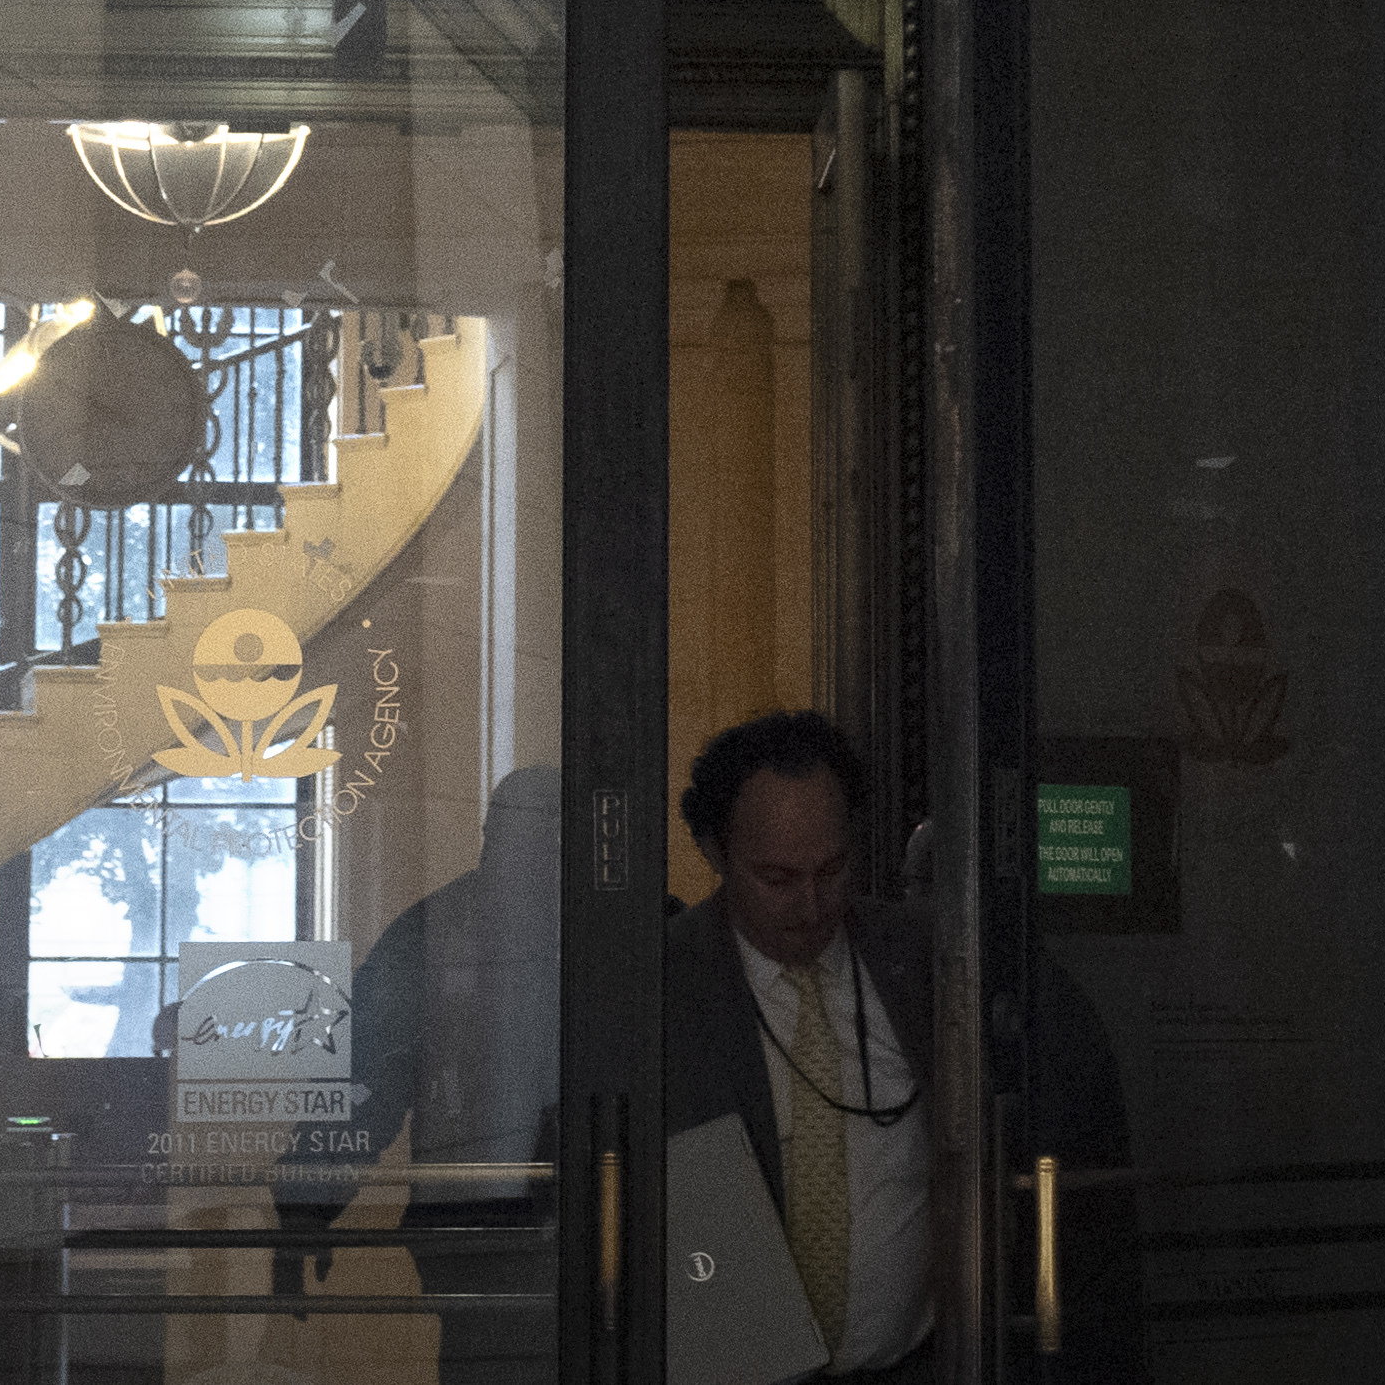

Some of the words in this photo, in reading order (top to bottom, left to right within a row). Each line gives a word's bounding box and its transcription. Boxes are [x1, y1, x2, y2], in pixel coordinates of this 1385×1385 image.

[362, 647, 401, 776] AGENCY
[600, 795, 622, 884] PULL
[1068, 820, 1105, 835] RELEASE
[183, 1090, 277, 1115] ENERGY
[283, 1089, 345, 1114] STAR
[147, 1132, 198, 1155] 2011
[205, 1131, 301, 1154] ENERGY
[310, 1129, 371, 1153] STAR
[140, 1162, 257, 1185] CERTIFIED
